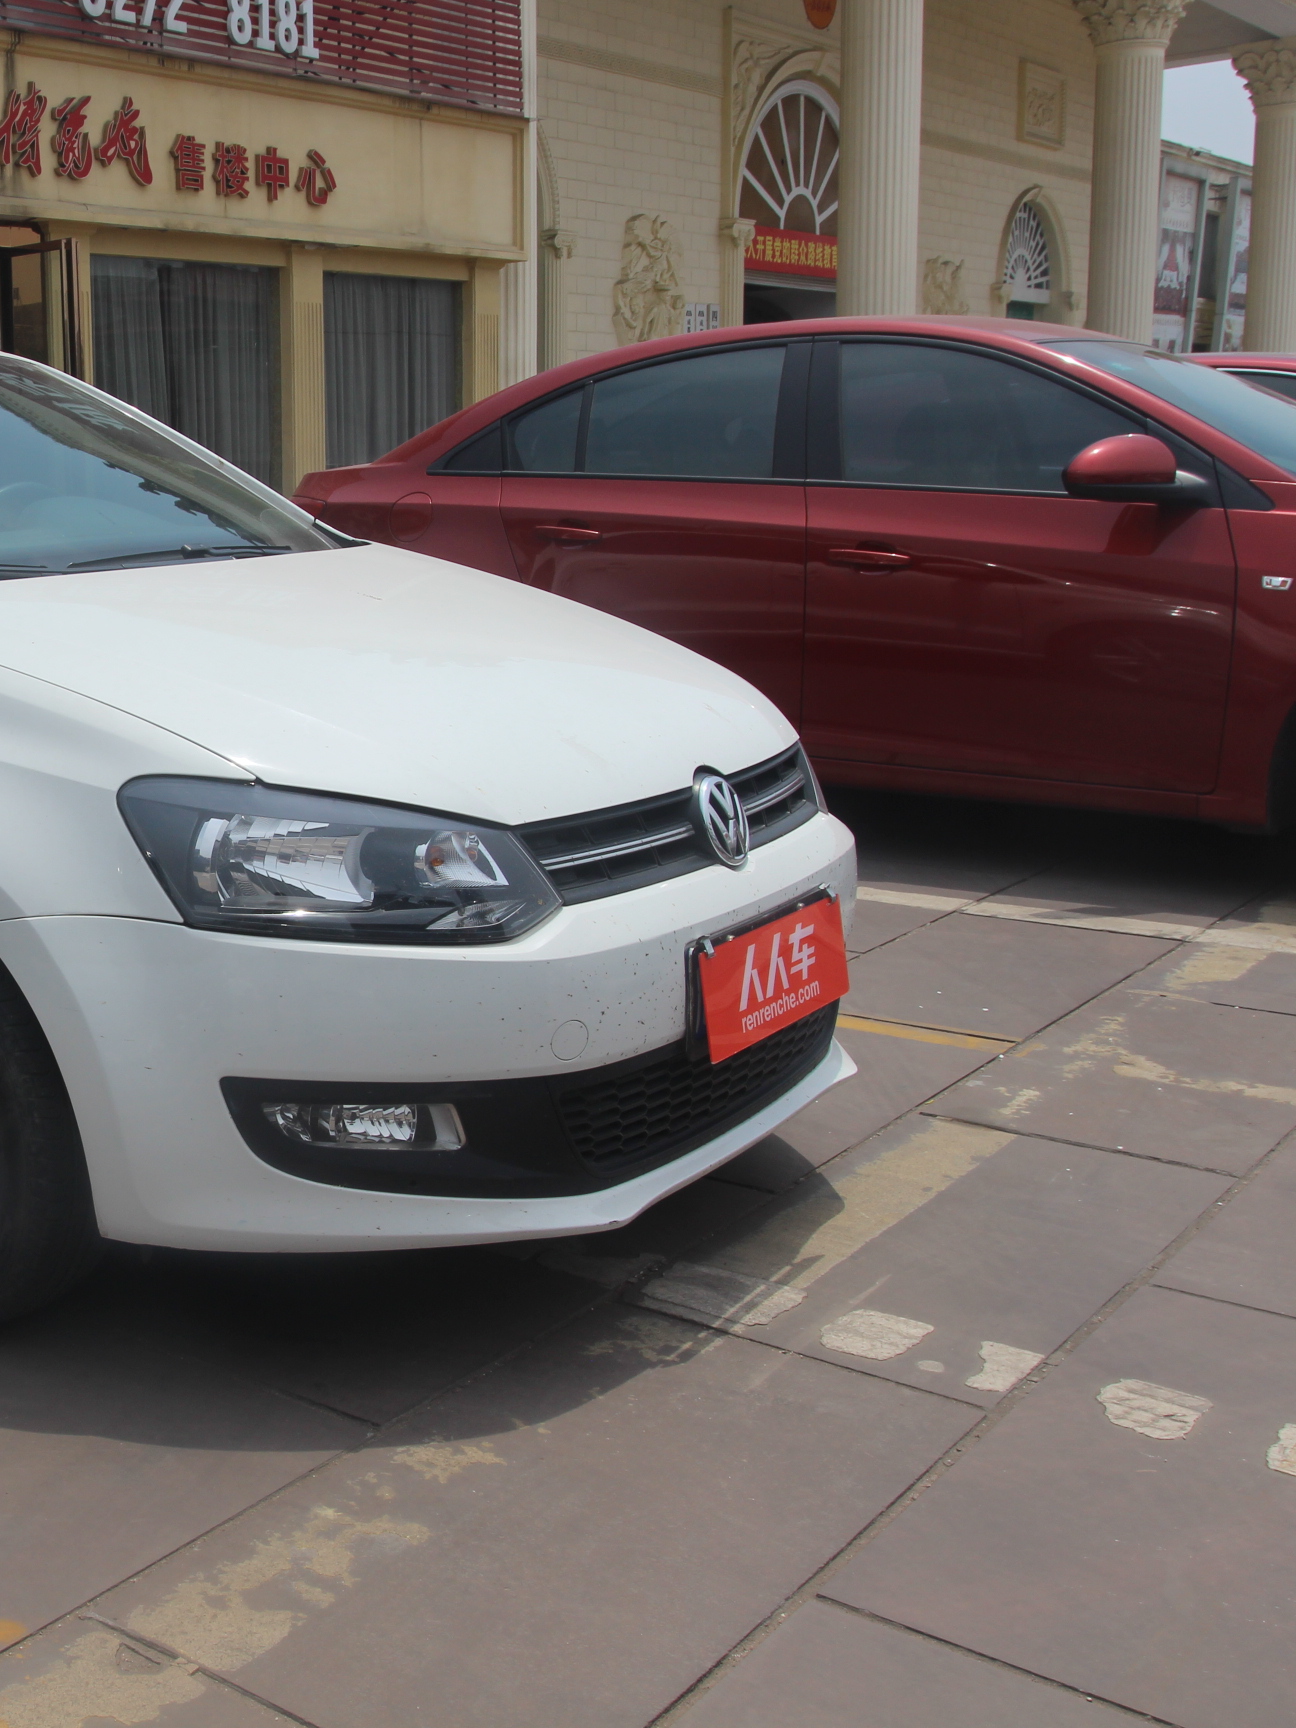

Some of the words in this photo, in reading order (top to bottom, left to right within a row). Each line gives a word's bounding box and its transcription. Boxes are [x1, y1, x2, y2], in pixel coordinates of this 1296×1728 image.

[227, 0, 320, 59] 8181
[171, 132, 337, 206] 售楼中心
[744, 235, 838, 271] 入开展党的群众路线教育
[739, 922, 816, 1013] 人人车
[741, 980, 821, 1034] renrenche.com
